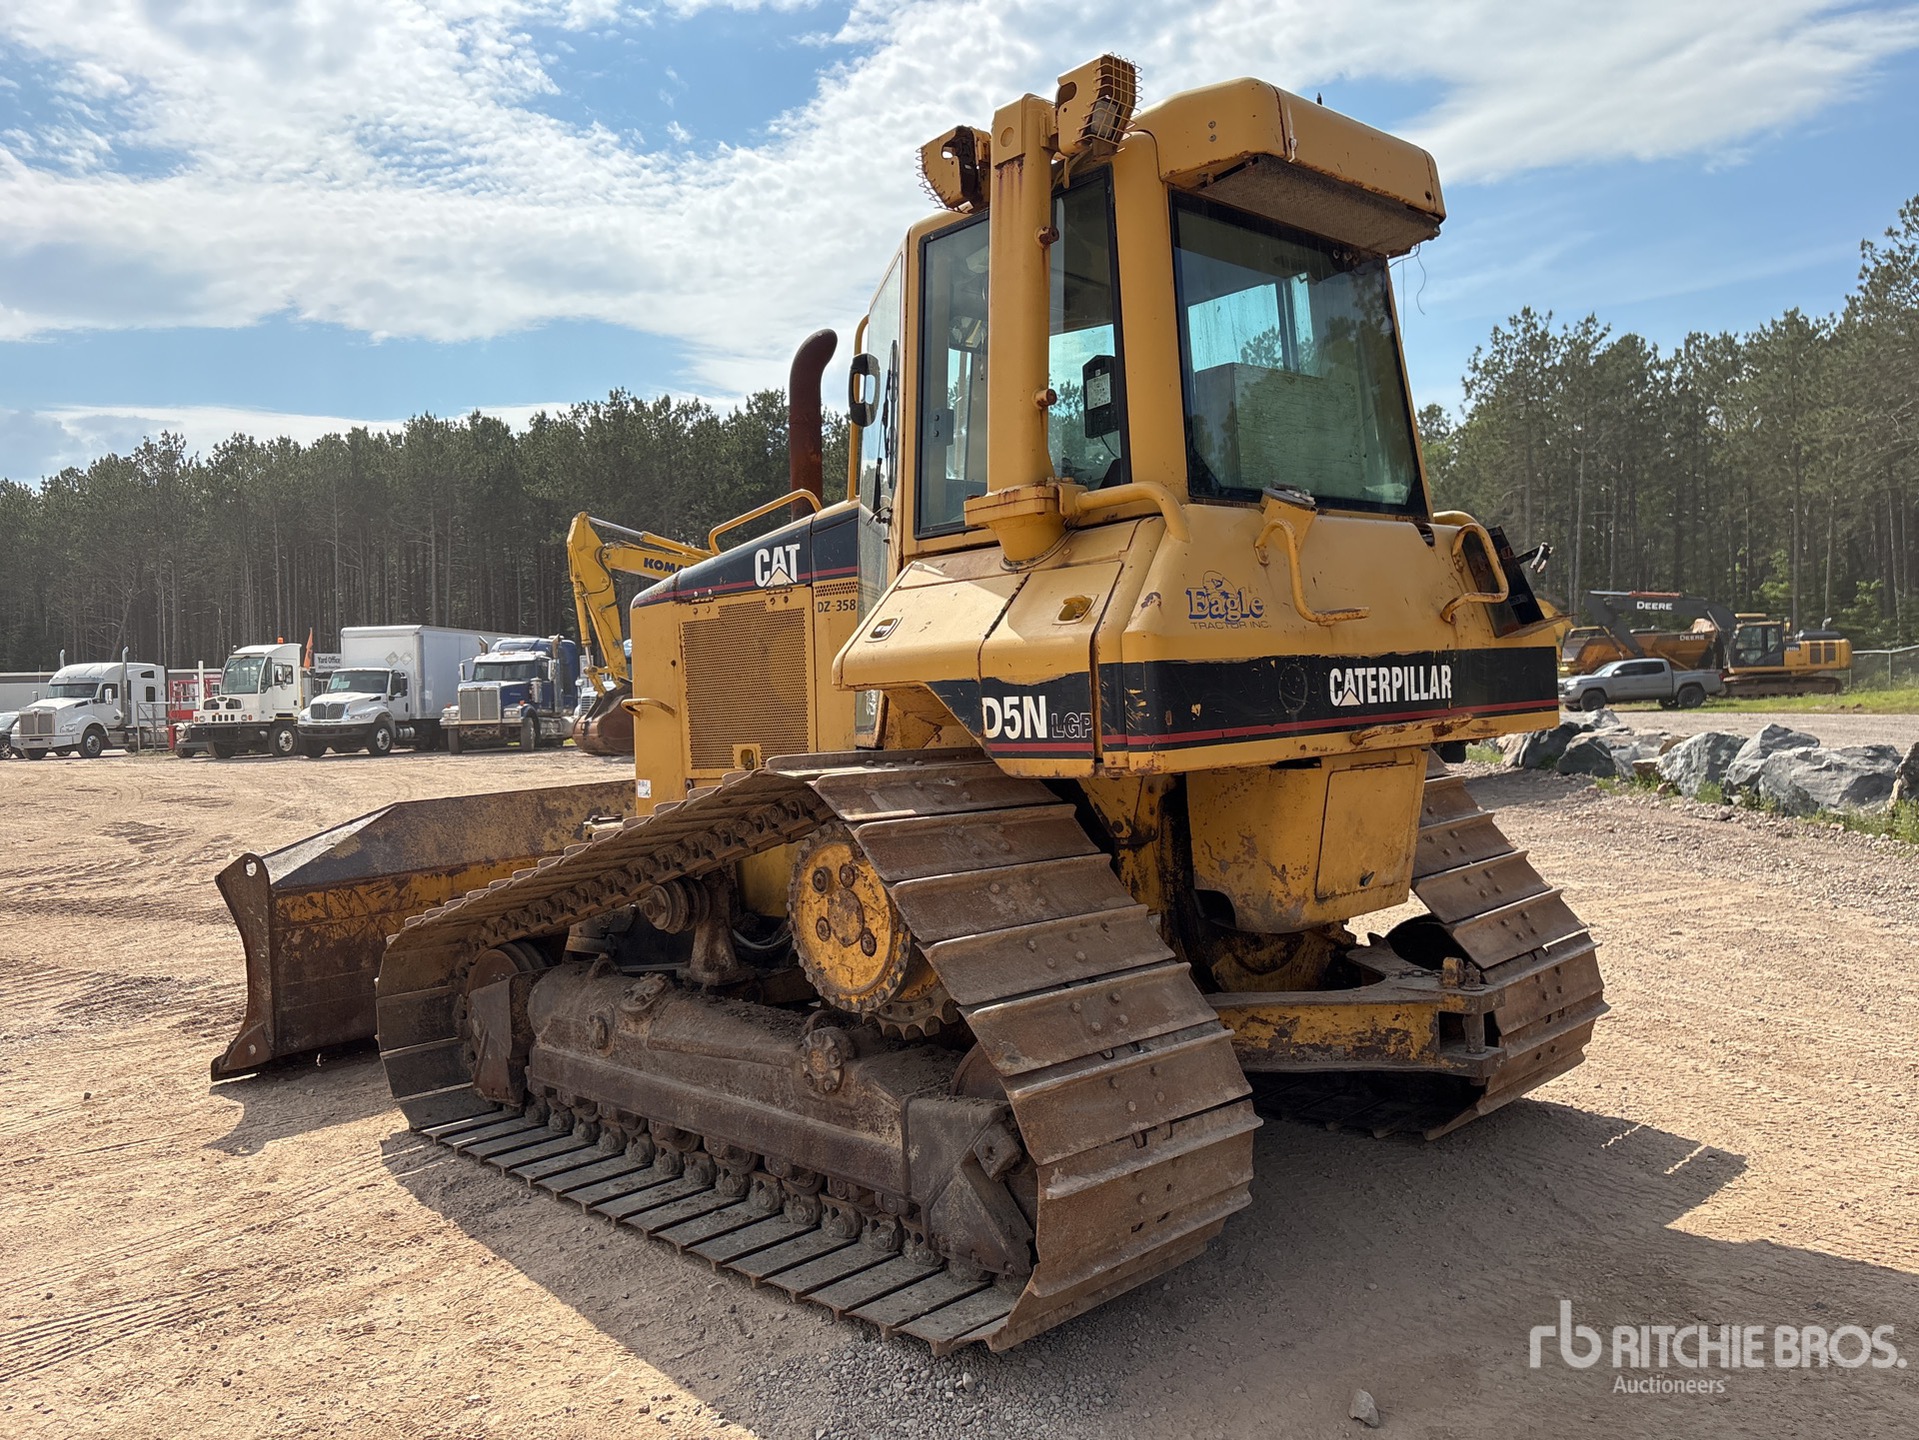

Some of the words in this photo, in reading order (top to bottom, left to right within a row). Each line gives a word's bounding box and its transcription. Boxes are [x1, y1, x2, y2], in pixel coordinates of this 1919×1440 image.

[643, 557, 692, 573] KOMA
[754, 543, 800, 588] CAT
[817, 599, 857, 613] DZ-358
[1185, 587, 1264, 623] Eagle
[1636, 601, 1673, 610] DEERE
[1190, 621, 1247, 630] TRACTOR
[1329, 664, 1452, 707] CATERPILLAR
[981, 695, 1048, 740] D5N
[1051, 711, 1093, 739] LGP
